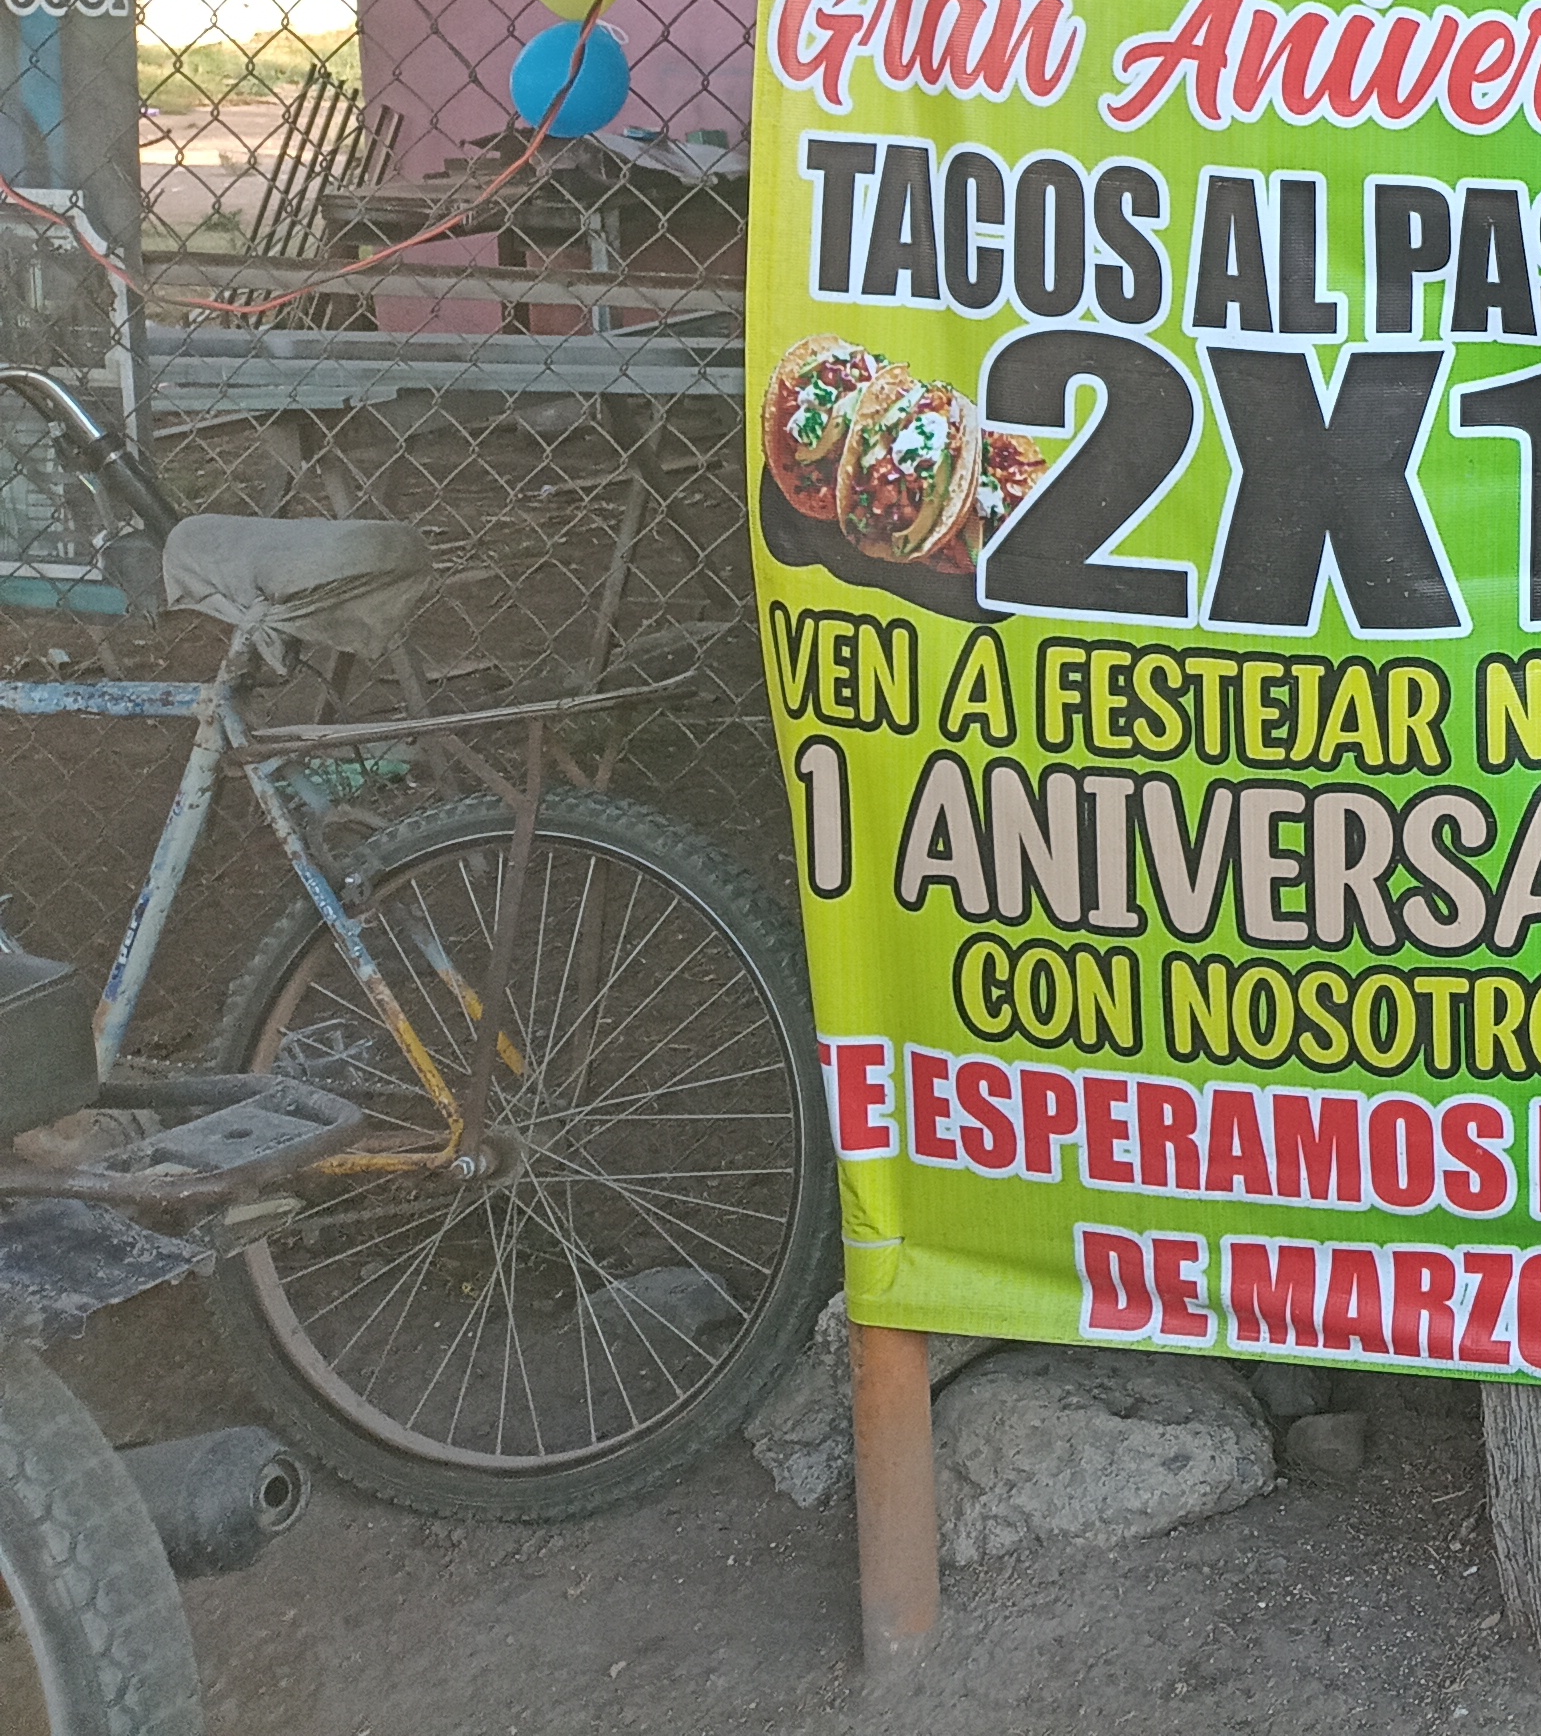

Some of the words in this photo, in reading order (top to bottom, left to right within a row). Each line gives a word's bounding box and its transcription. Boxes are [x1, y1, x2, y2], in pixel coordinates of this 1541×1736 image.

[807, 143, 1166, 325] TACOS
[1196, 176, 1340, 334] AL
[772, 611, 914, 732] VEN
[945, 629, 1007, 743] A
[1041, 639, 1450, 774] FESTEJAR
[796, 736, 850, 895] 1
[953, 935, 1139, 1054] CON
[910, 1049, 1508, 1215] ESPERAMOS
[1081, 1230, 1208, 1339] DE
